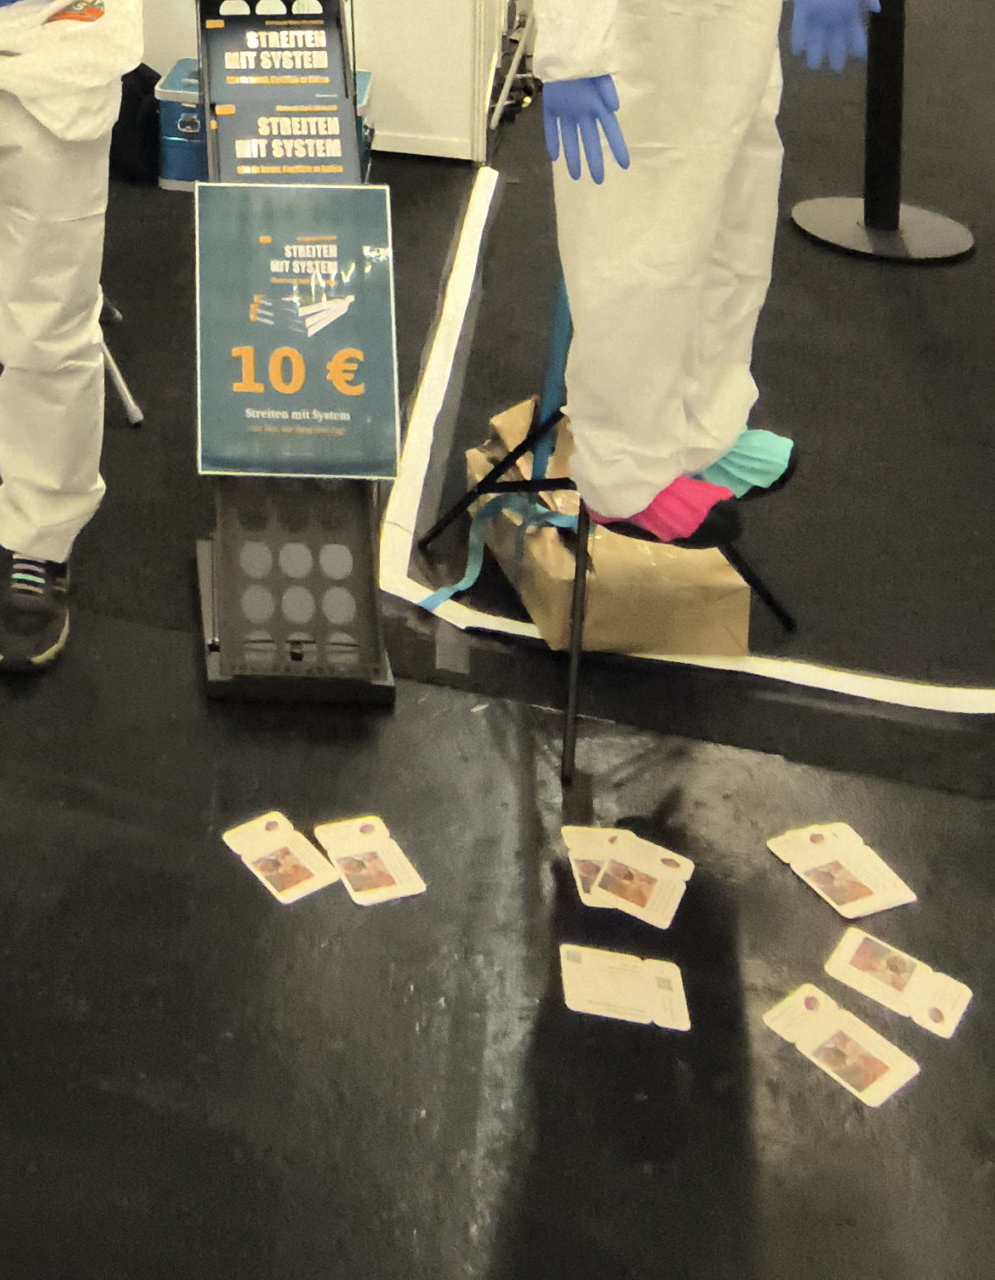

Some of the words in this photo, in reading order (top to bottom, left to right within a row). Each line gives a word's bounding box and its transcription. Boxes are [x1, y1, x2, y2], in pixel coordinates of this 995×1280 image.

[246, 30, 326, 49] STREITEN
[224, 51, 257, 70] MIT
[260, 50, 329, 70] SYSTEM
[257, 116, 340, 136] STREITEN
[235, 139, 268, 159] MIT
[271, 138, 342, 158] SYSTEM
[231, 346, 306, 395] 10
[325, 347, 365, 396] €
[245, 407, 289, 419] Streiten
[291, 408, 310, 420] mit
[312, 408, 351, 422] System
